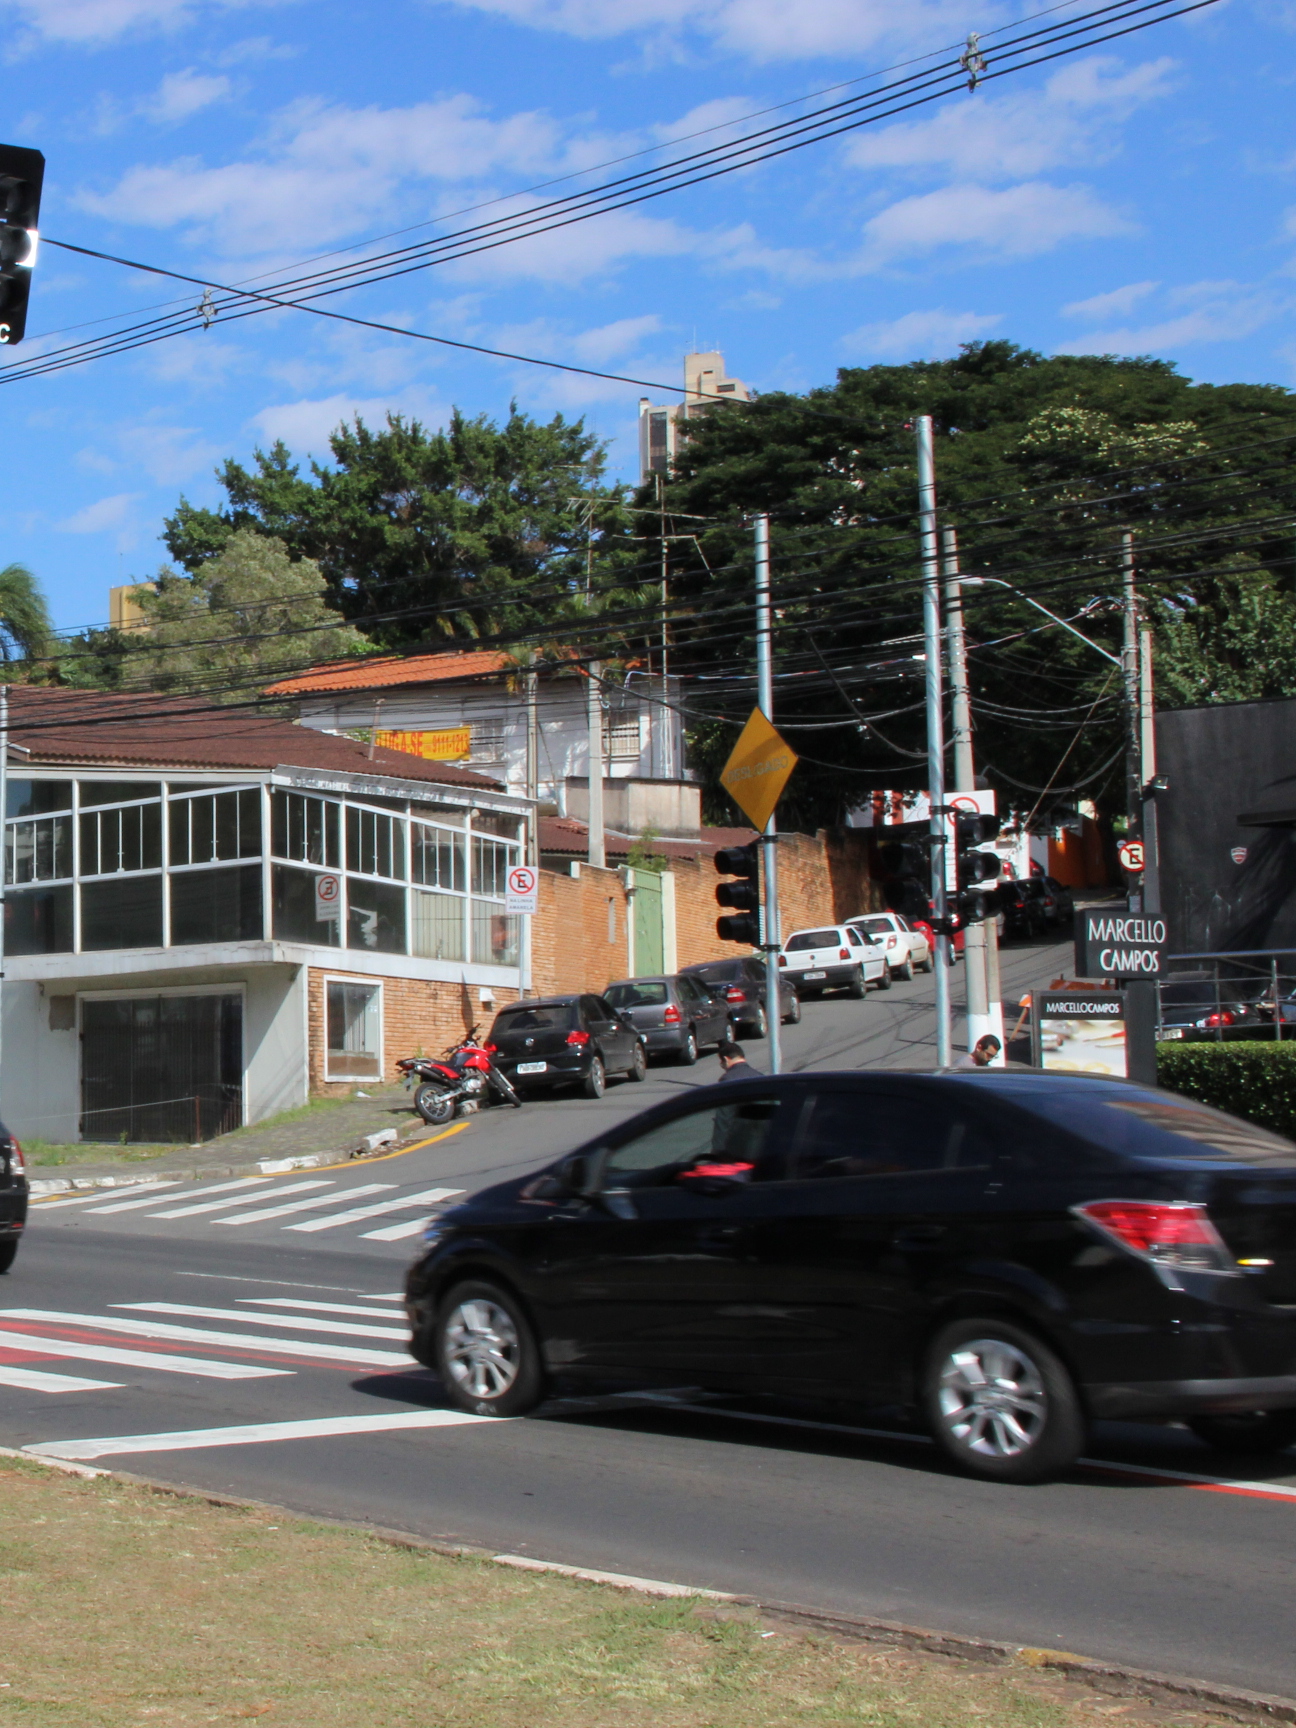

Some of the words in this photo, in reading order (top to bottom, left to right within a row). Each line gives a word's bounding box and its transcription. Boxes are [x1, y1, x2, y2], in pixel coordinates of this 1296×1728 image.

[727, 755, 790, 784] DESLIGADO
[1088, 918, 1166, 944] MARCELLO
[1099, 949, 1160, 973] CAMPOS
